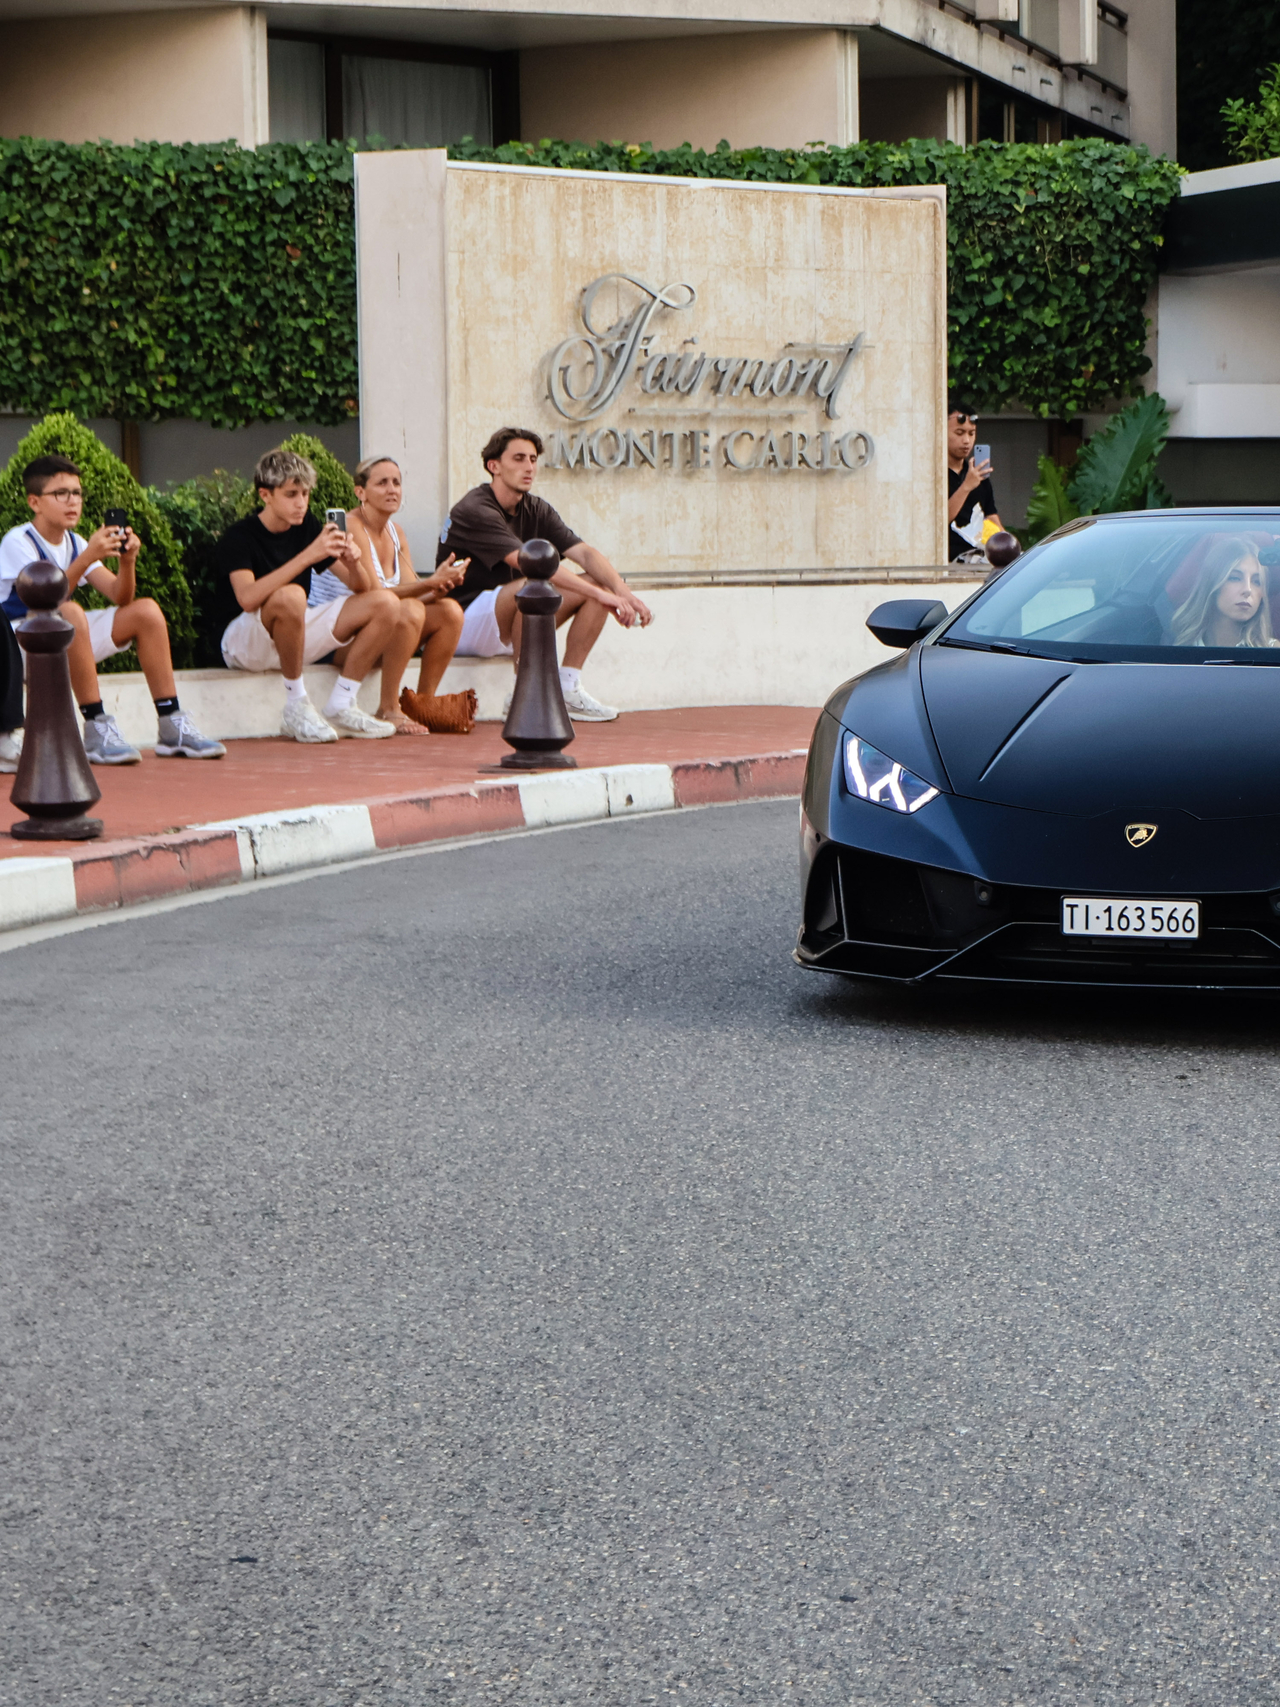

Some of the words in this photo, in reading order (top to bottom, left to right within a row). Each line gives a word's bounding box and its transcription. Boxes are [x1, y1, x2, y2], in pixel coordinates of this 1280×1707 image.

[547, 272, 876, 422] Fairmont
[544, 427, 711, 470] MONTE
[723, 429, 876, 471] CARLO
